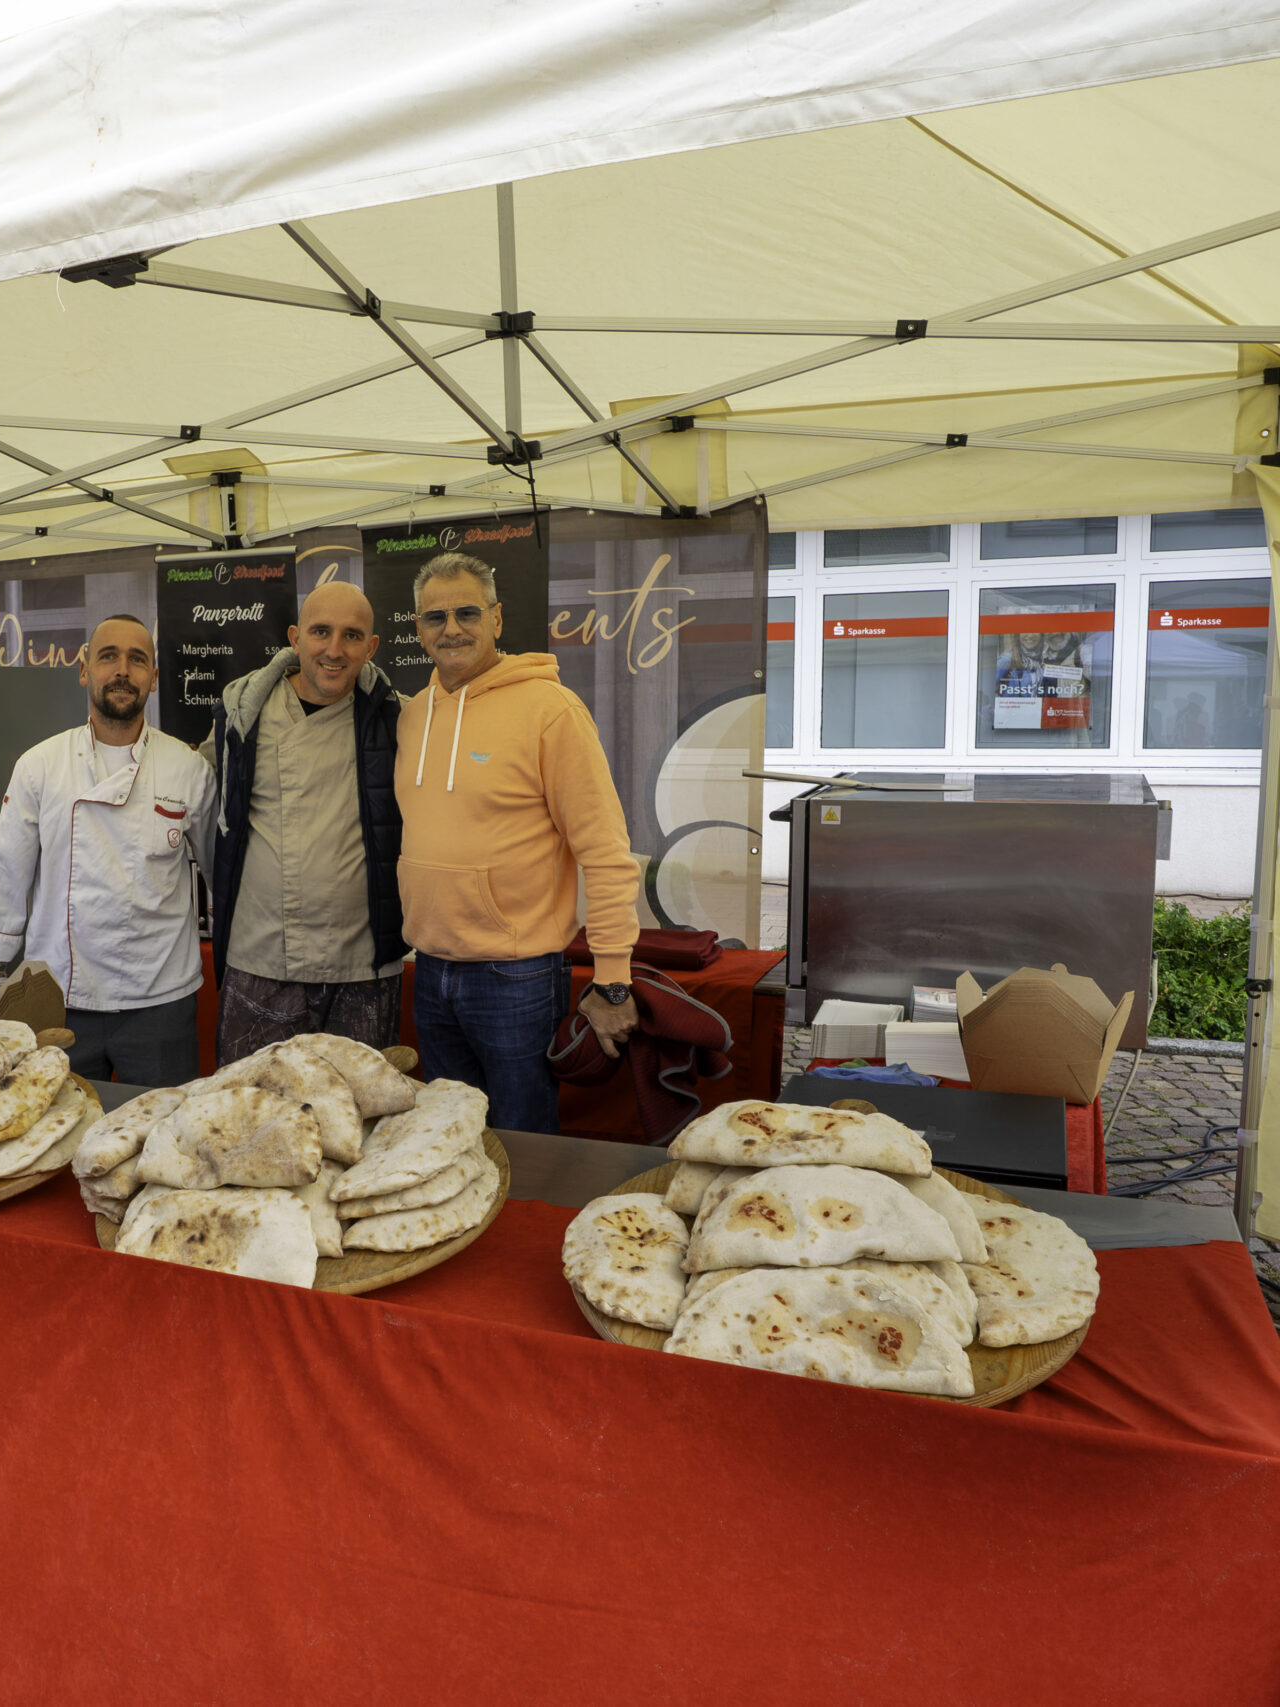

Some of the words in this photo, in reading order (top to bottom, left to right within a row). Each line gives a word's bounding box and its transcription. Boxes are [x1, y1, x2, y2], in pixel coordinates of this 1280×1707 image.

[192, 602, 264, 627] Panzerotti
[1177, 618, 1221, 627] Sparkasse
[848, 628, 886, 636] Sparkasse
[182, 644, 234, 658] Margherita
[184, 669, 215, 681] Salami
[1047, 684, 1085, 695] noch?
